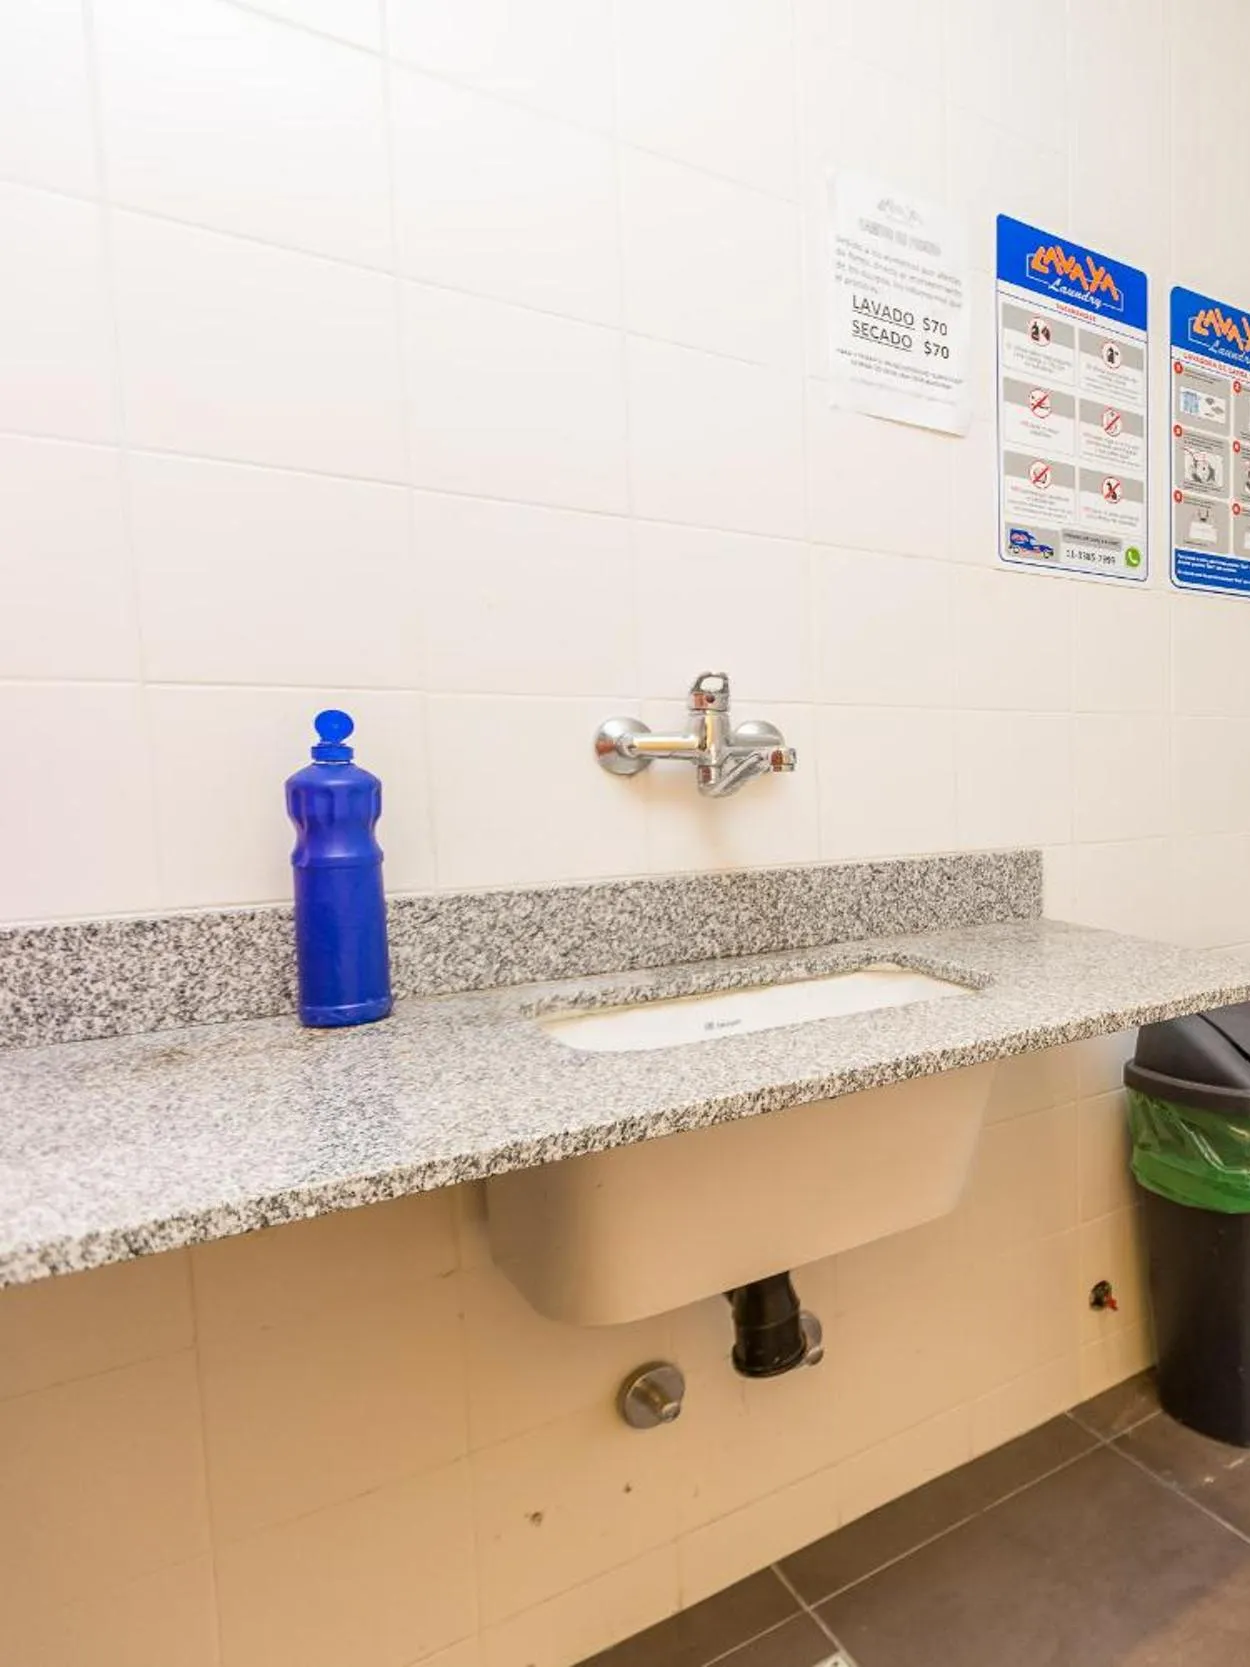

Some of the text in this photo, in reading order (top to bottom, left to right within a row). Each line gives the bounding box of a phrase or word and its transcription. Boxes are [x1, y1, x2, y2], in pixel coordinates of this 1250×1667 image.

[1048, 278, 1102, 309] Laundry
[852, 294, 948, 336] LAVADO $70
[852, 319, 950, 359] SECADO $70
